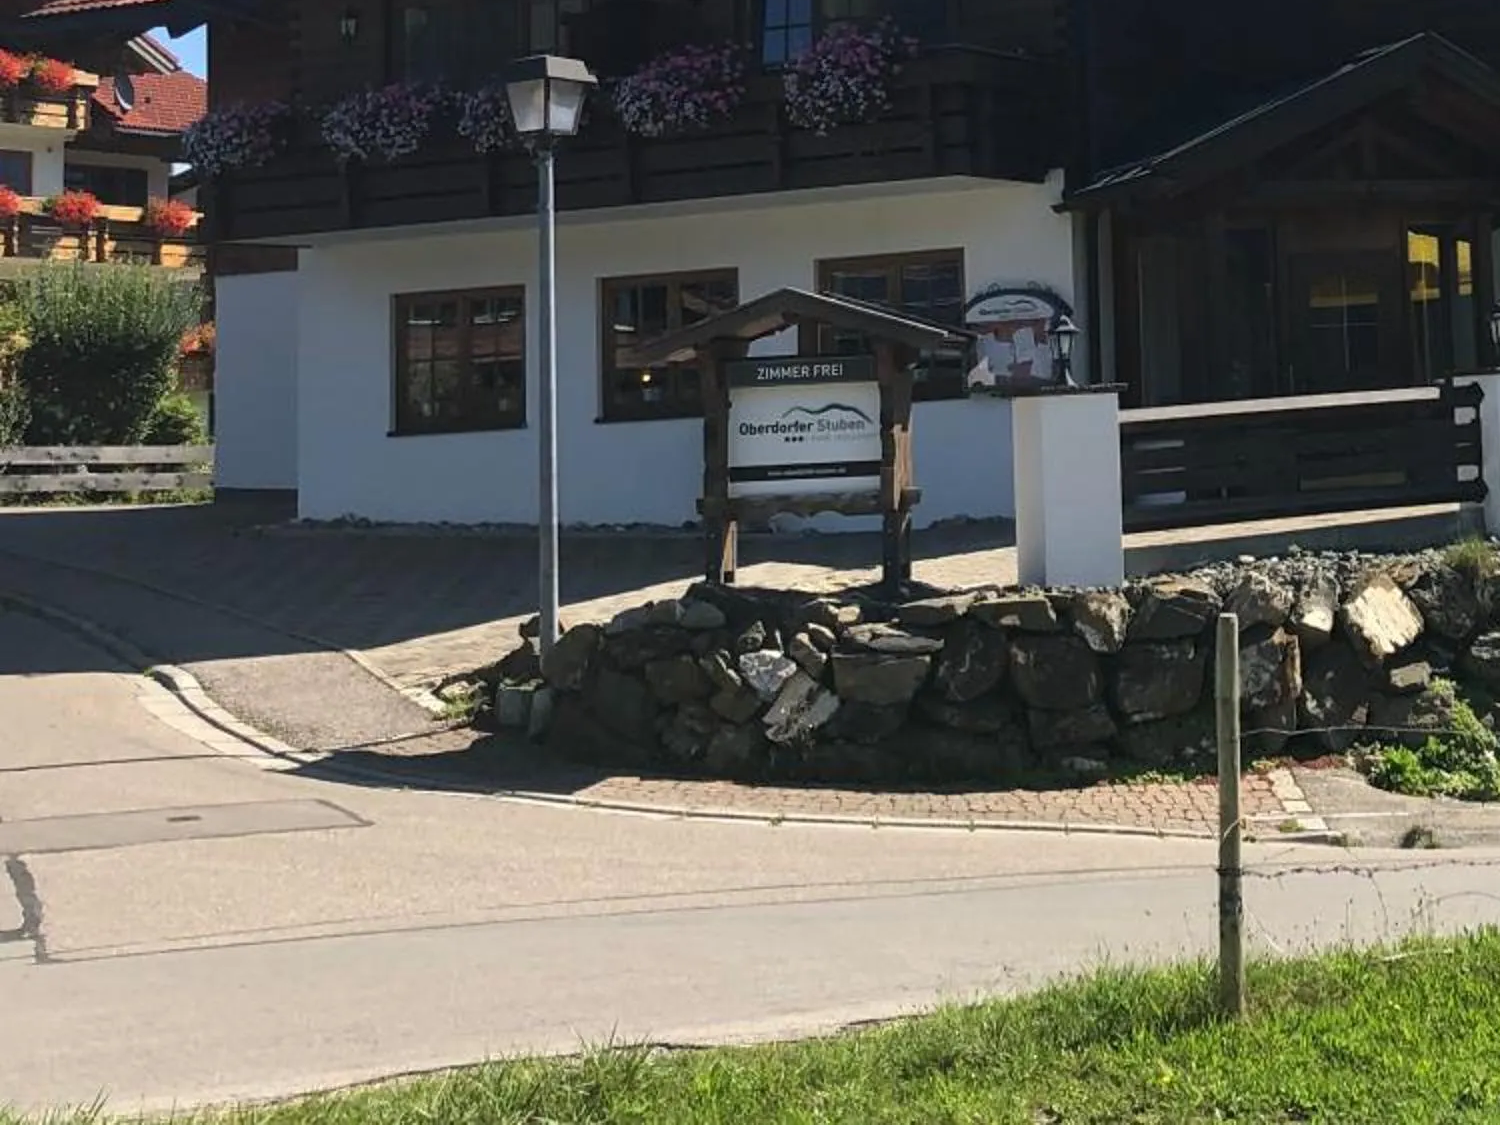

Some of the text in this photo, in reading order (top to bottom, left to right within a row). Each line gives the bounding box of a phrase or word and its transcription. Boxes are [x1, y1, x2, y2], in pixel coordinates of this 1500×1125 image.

[757, 363, 843, 380] ZIMMER FREI
[739, 418, 866, 436] Oberdorfer Stuben
